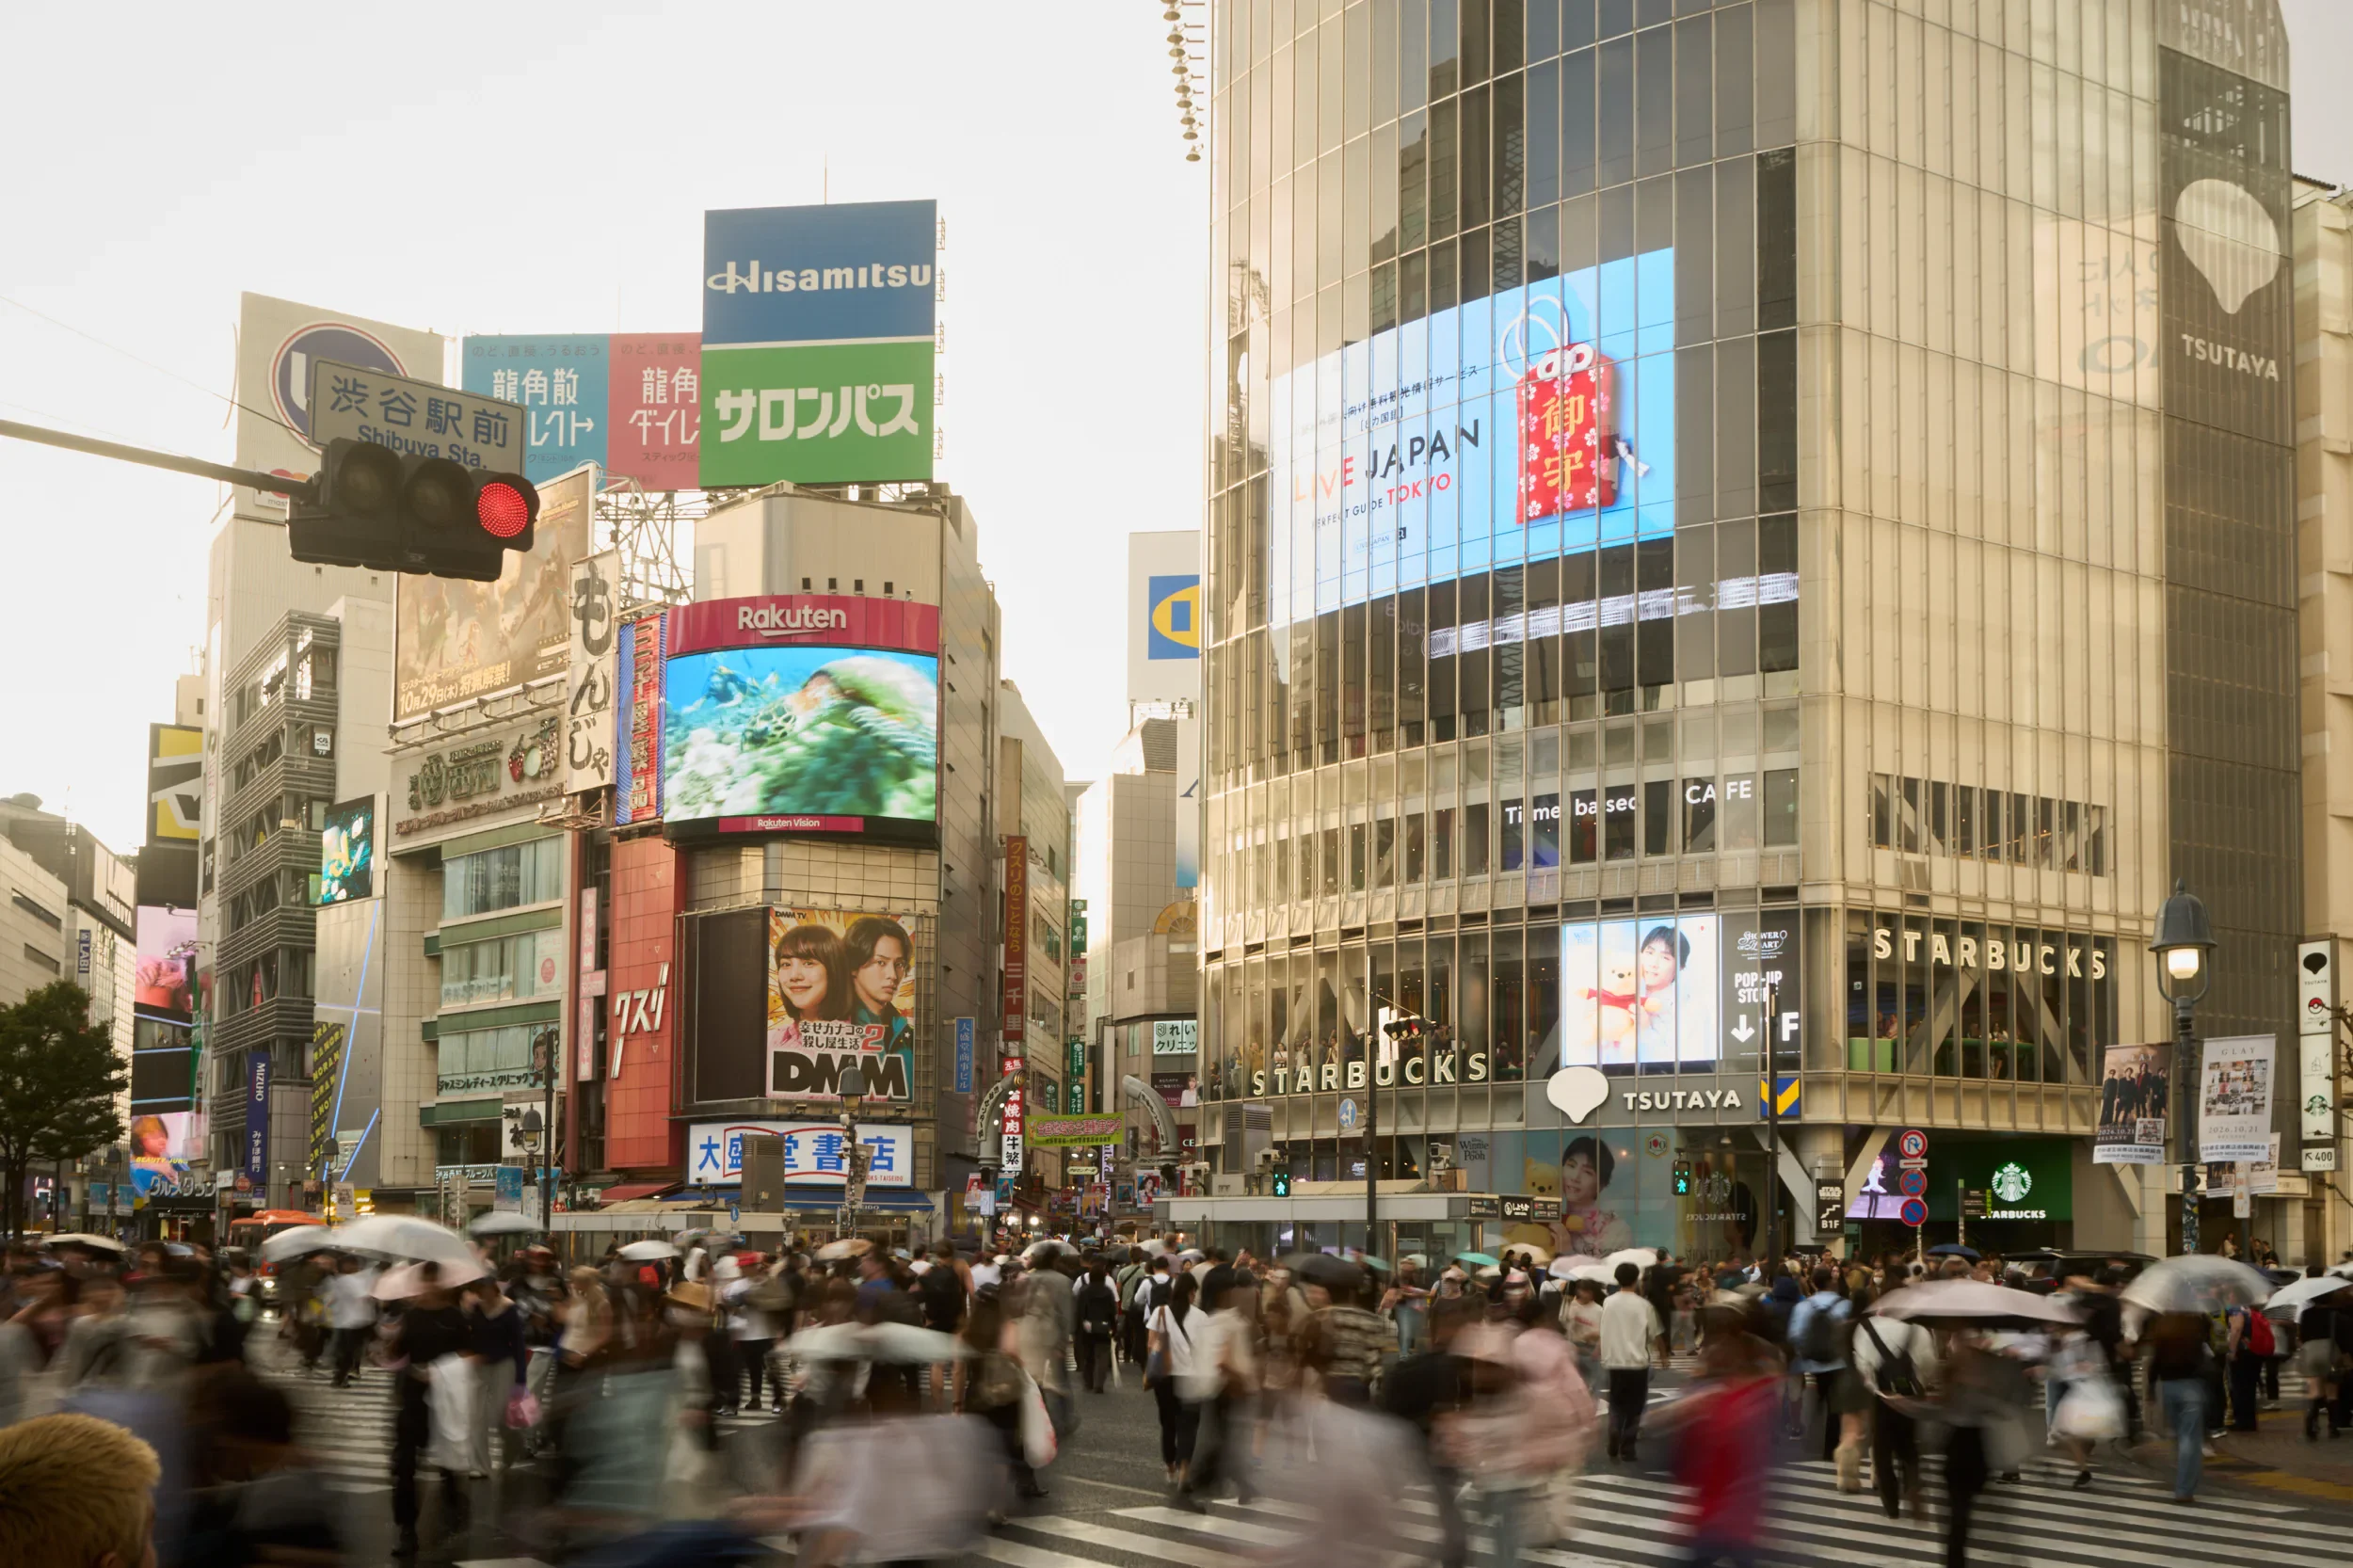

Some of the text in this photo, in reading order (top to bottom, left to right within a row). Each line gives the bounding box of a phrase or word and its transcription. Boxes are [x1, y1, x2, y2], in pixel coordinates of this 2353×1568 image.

[706, 260, 932, 294] Hisamitsu
[2182, 333, 2279, 381] TSUTAYA
[492, 367, 580, 406] 龍角散
[329, 375, 509, 450] 渋谷駅前
[530, 410, 595, 448] レクト
[628, 408, 701, 446] ダイレ
[714, 383, 919, 442] サロンパス
[358, 424, 488, 470] Shibuya Sta.
[1541, 392, 1586, 492] 御守
[1294, 418, 1479, 503] LIVE JAPAN
[1353, 497, 1383, 517] GUDE
[1386, 472, 1451, 505] TOKYO
[737, 603, 847, 632] Rakuten
[568, 560, 613, 781] もんじゃ
[1686, 779, 1753, 806] CAFE
[758, 816, 820, 828] Rakuten Vision
[1505, 804, 1561, 824] Time
[775, 910, 795, 919] DMM
[1004, 841, 1025, 1032] クスリのことなら 三千里
[79, 942, 90, 973] LABI
[1874, 928, 2106, 980] STARBUCKS
[1737, 987, 1779, 1004] STOR
[800, 1021, 863, 1035] 幸せカナコの
[860, 1024, 885, 1051] 2
[2221, 1047, 2256, 1056] GLAY
[255, 1063, 265, 1101] MIZUHO
[772, 1050, 908, 1099] DMM
[1253, 1052, 1488, 1096] STARBUCKS
[1624, 1089, 1741, 1111] TSUTAYA
[251, 1130, 262, 1173] みずほ銀行
[1005, 1136, 1020, 1166] 牛繁
[1459, 1140, 1489, 1150] Winnie
[1464, 1150, 1485, 1161] Pooh
[2314, 1150, 2333, 1162] 400
[150, 1175, 216, 1197] グルメタウン
[1821, 1220, 1839, 1228] B1F
